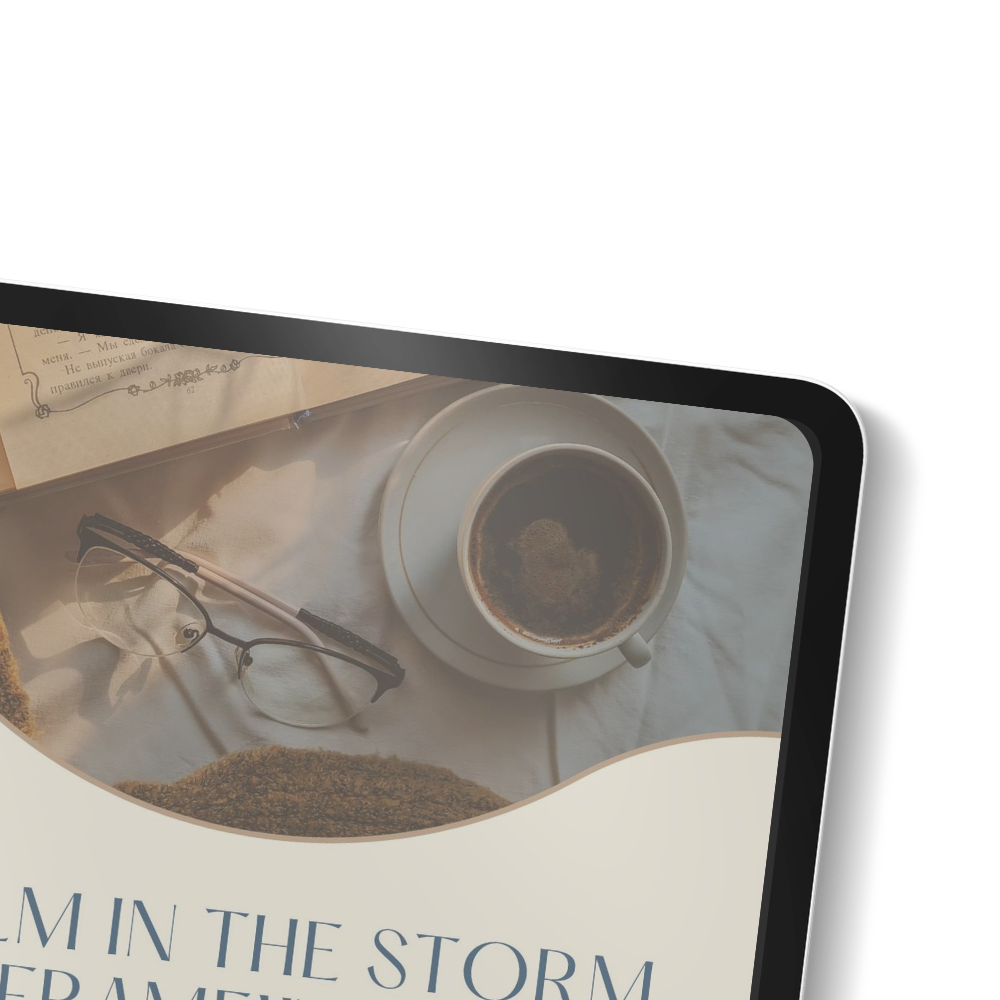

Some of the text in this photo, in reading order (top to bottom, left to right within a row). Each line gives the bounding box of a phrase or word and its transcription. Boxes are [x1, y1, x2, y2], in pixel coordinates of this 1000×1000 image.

[97, 341, 118, 353] Мы
[65, 363, 82, 375] Не
[86, 352, 137, 370] выпуская
[50, 363, 153, 395] правился к двери.
[186, 385, 195, 394] 62
[107, 897, 177, 962] IN
[206, 907, 343, 982] THE
